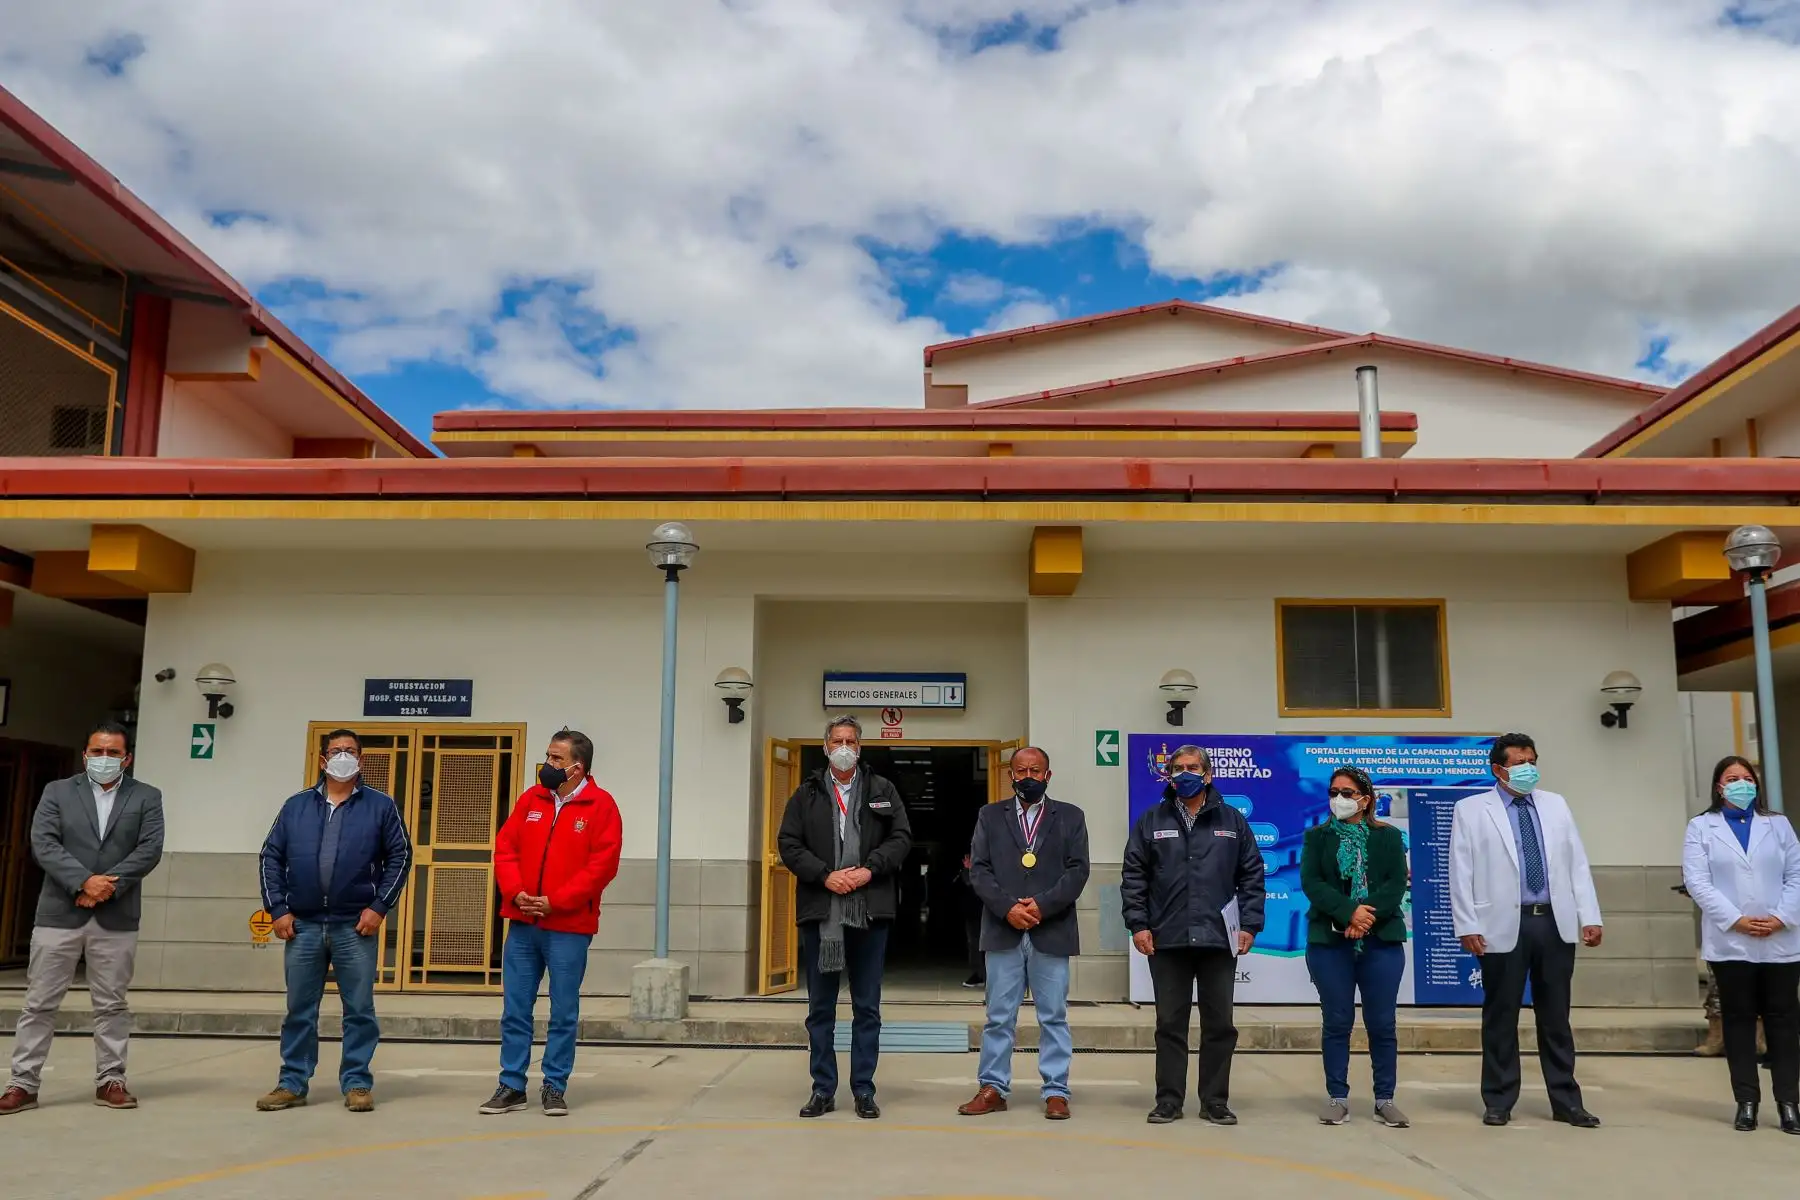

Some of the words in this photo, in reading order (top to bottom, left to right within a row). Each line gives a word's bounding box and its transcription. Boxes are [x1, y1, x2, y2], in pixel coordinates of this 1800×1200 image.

[369, 694, 392, 702] HOSP.
[828, 690, 870, 699] SERVICIOS
[872, 690, 918, 699] GENERALES
[1205, 747, 1252, 758] BIERNO
[1305, 747, 1384, 755] FORTALECIMIENTO
[1411, 748, 1460, 756] CAPACIDAD
[1355, 756, 1398, 765] ATENCIÓN
[1400, 757, 1442, 765] INTEGRAL
[1456, 758, 1484, 766] SALUD
[1376, 764, 1405, 774] CÉSAR
[1406, 766, 1443, 774] VALLEJO
[1444, 766, 1487, 775] MENDOZA
